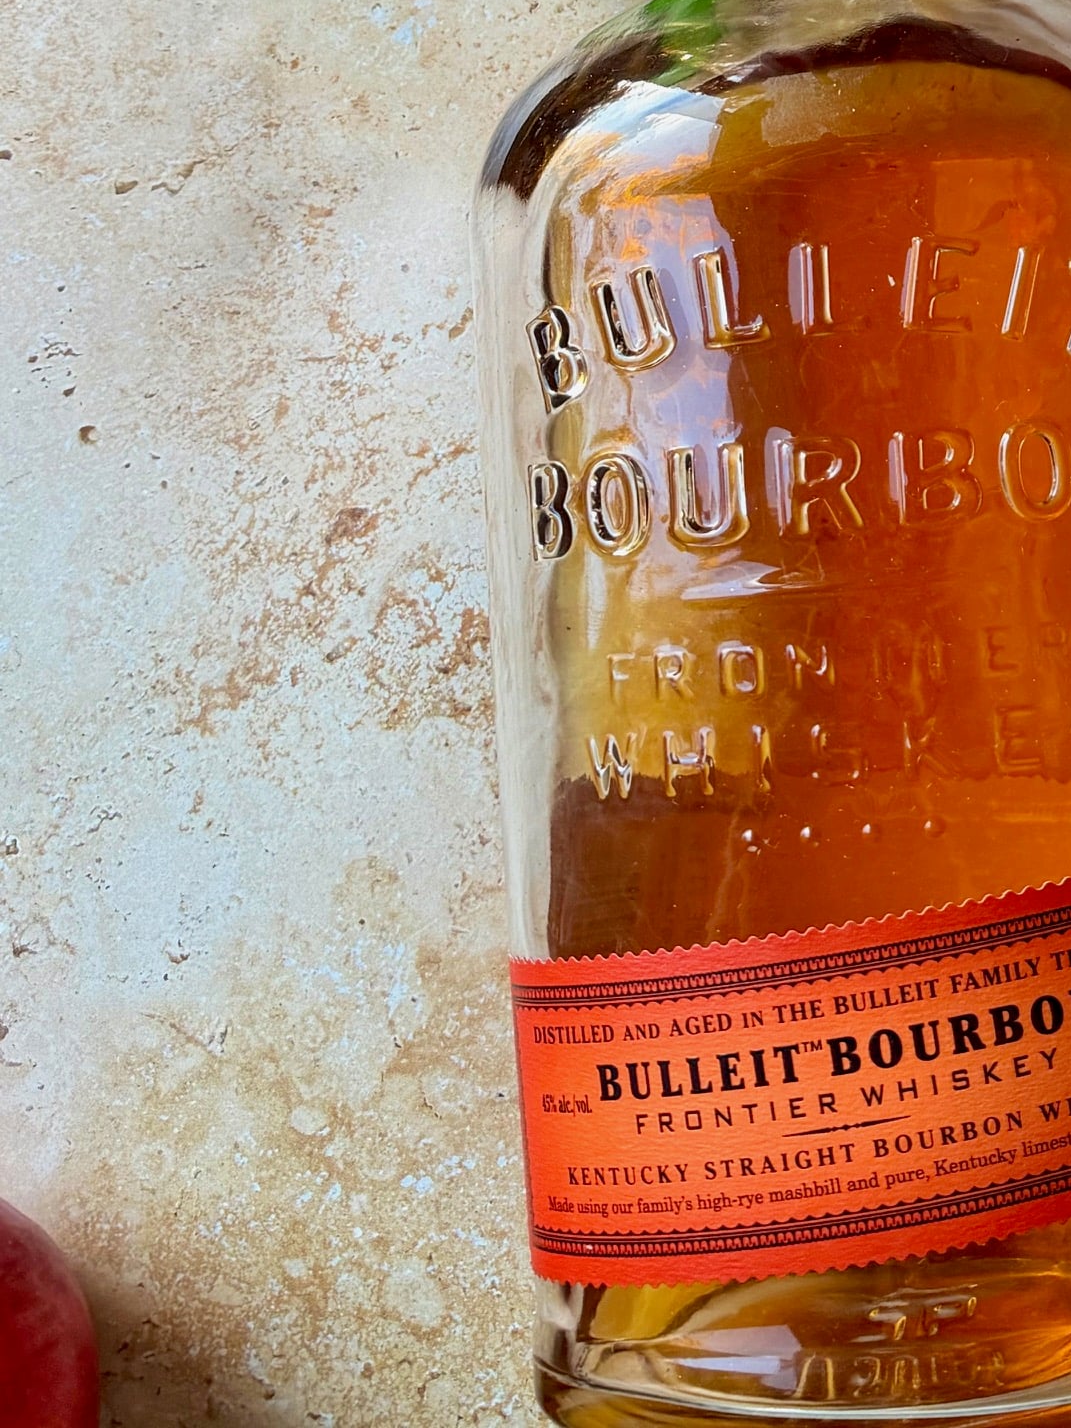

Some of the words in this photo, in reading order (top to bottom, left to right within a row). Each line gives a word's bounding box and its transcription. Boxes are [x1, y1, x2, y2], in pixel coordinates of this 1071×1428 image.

[534, 1024, 614, 1045] DISTILLED
[623, 1023, 660, 1041] AND
[670, 1013, 732, 1037] AGED
[741, 1010, 764, 1029] IN
[772, 1000, 825, 1024] THE
[834, 979, 939, 1015] BULLEIT
[950, 956, 1041, 994] FAMILY
[636, 1093, 837, 1135] FRONTIER
[861, 1047, 1058, 1106] WHISKEY
[548, 1196, 575, 1214] Made
[577, 1199, 609, 1218] using
[612, 1200, 633, 1215] our
[697, 1190, 764, 1211] high-rye
[769, 1179, 842, 1203] mashbill
[847, 1172, 880, 1192] and
[885, 1164, 930, 1189] pure,
[934, 1147, 1017, 1177] Kentucky
[568, 1163, 689, 1186] KENTUCKY
[705, 1143, 856, 1181] STRAIGHT
[873, 1111, 1024, 1158] BOURBON
